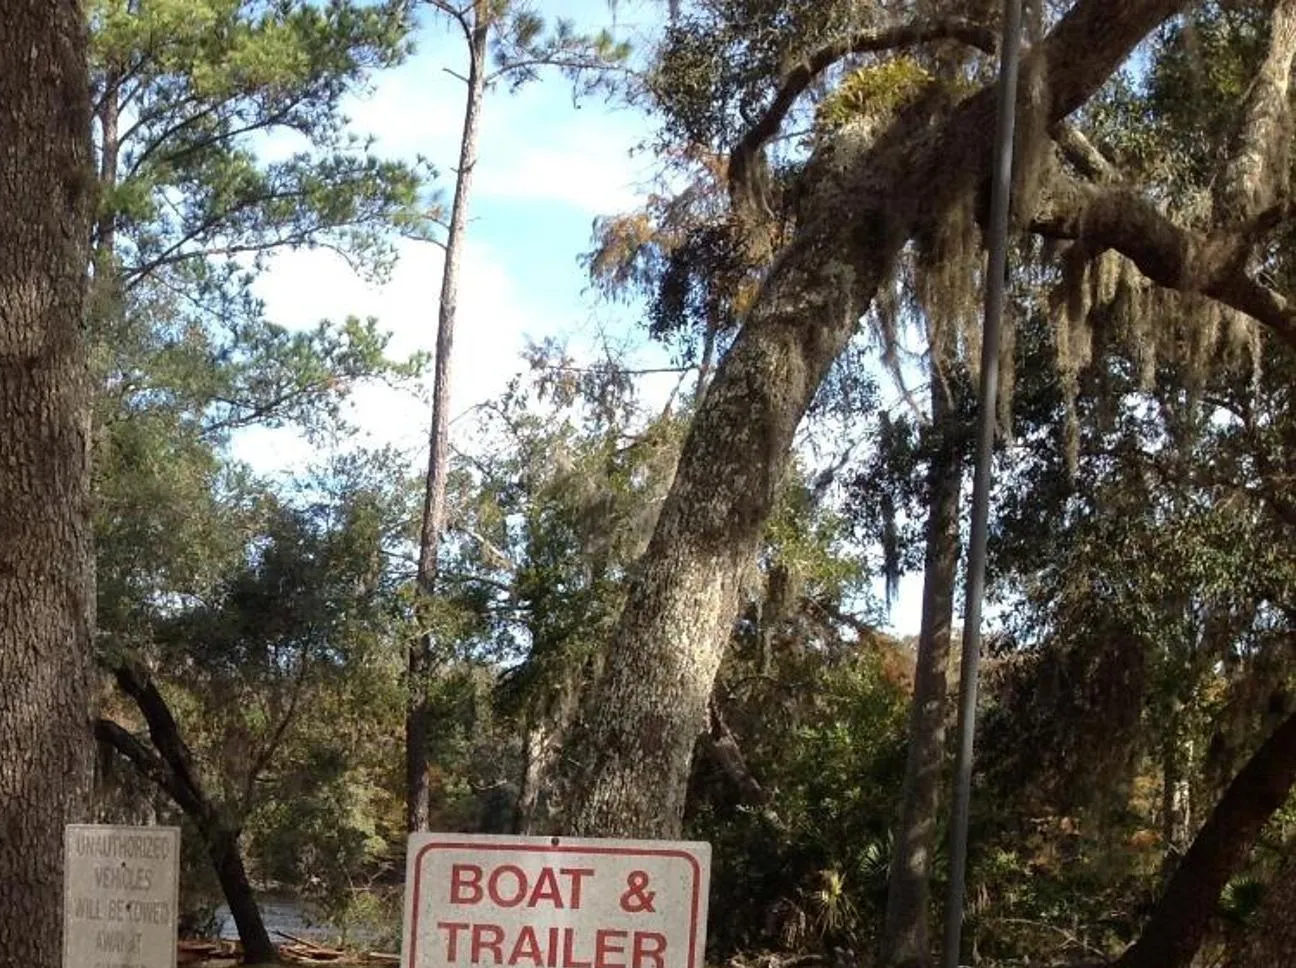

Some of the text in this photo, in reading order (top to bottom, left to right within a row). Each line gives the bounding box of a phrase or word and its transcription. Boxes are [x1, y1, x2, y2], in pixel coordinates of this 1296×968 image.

[94, 867, 153, 891] VEHICLES
[450, 863, 656, 913] BOAT &
[75, 897, 102, 920] WILL
[108, 899, 124, 921] BE
